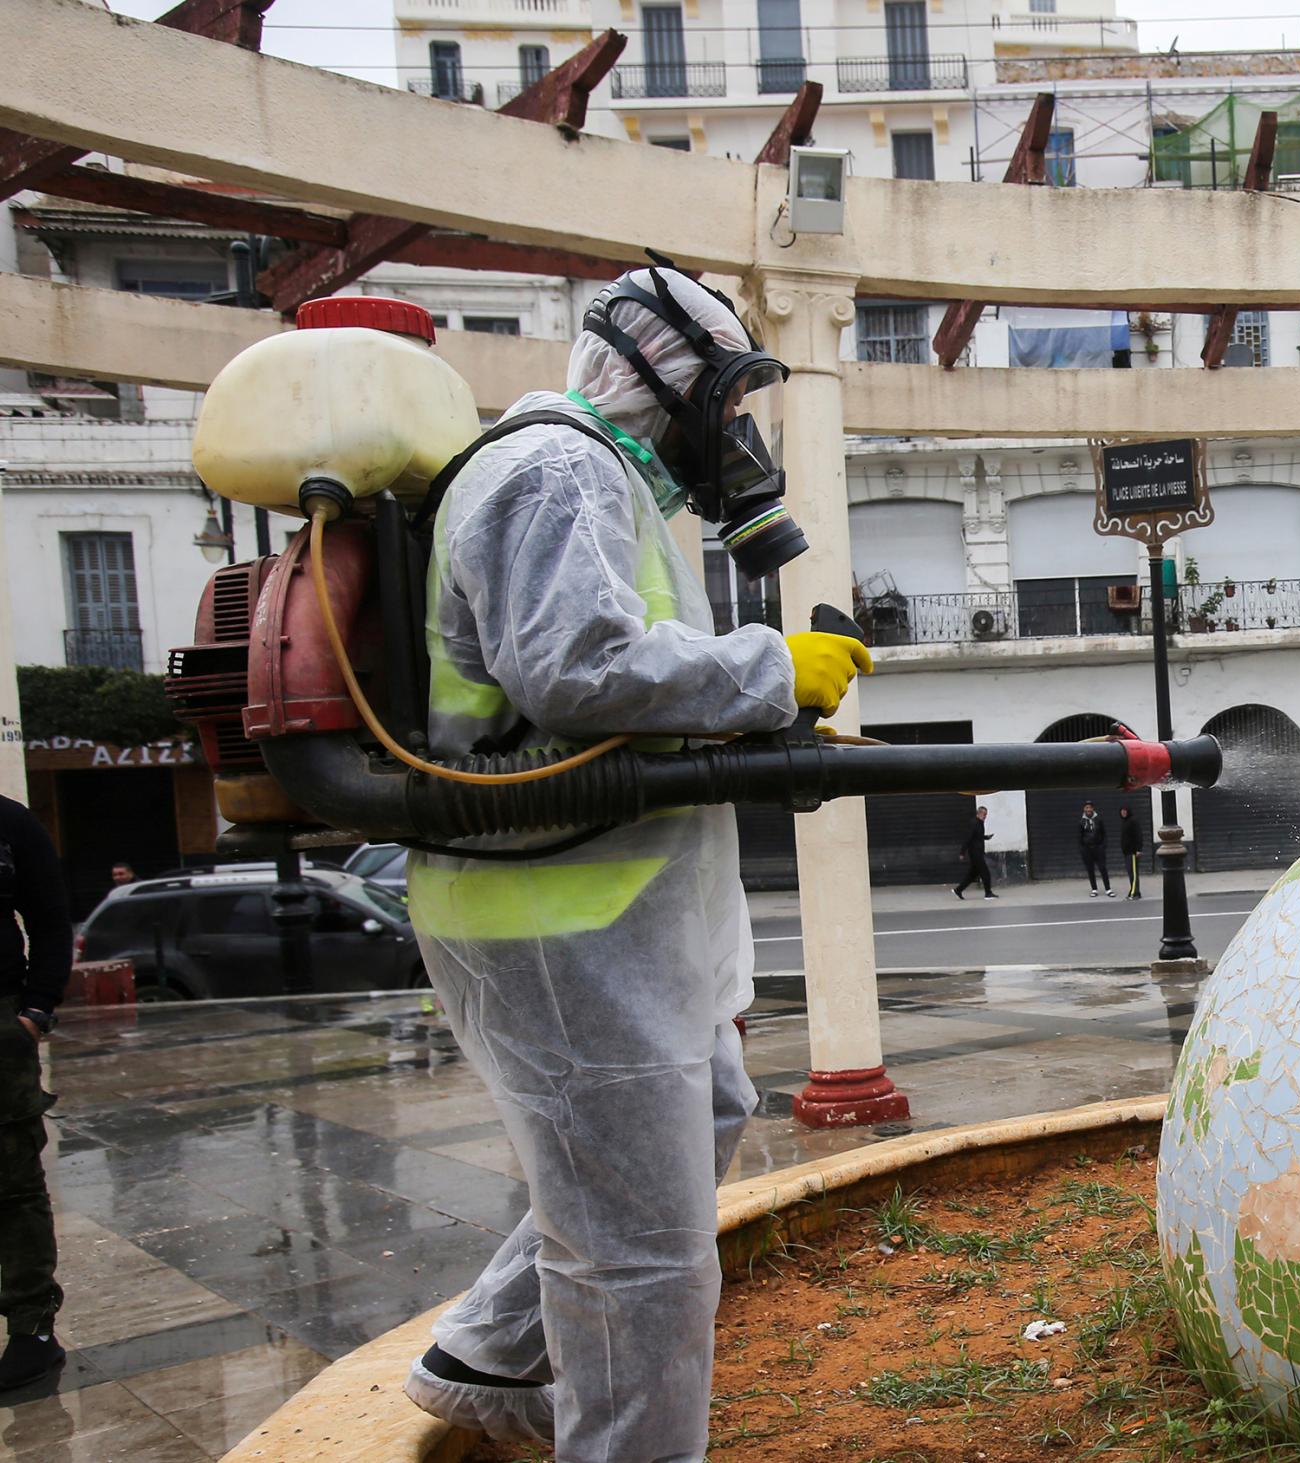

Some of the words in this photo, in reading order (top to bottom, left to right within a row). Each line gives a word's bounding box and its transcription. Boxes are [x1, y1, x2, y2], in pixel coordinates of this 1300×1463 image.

[1111, 456, 1143, 470] الصحافة
[1143, 454, 1163, 470] حرية
[1164, 452, 1184, 464] ساحة
[1112, 486, 1129, 501] PLACE
[1151, 483, 1159, 497] DE
[1159, 482, 1167, 496] LA
[1167, 480, 1186, 495] PRESSE
